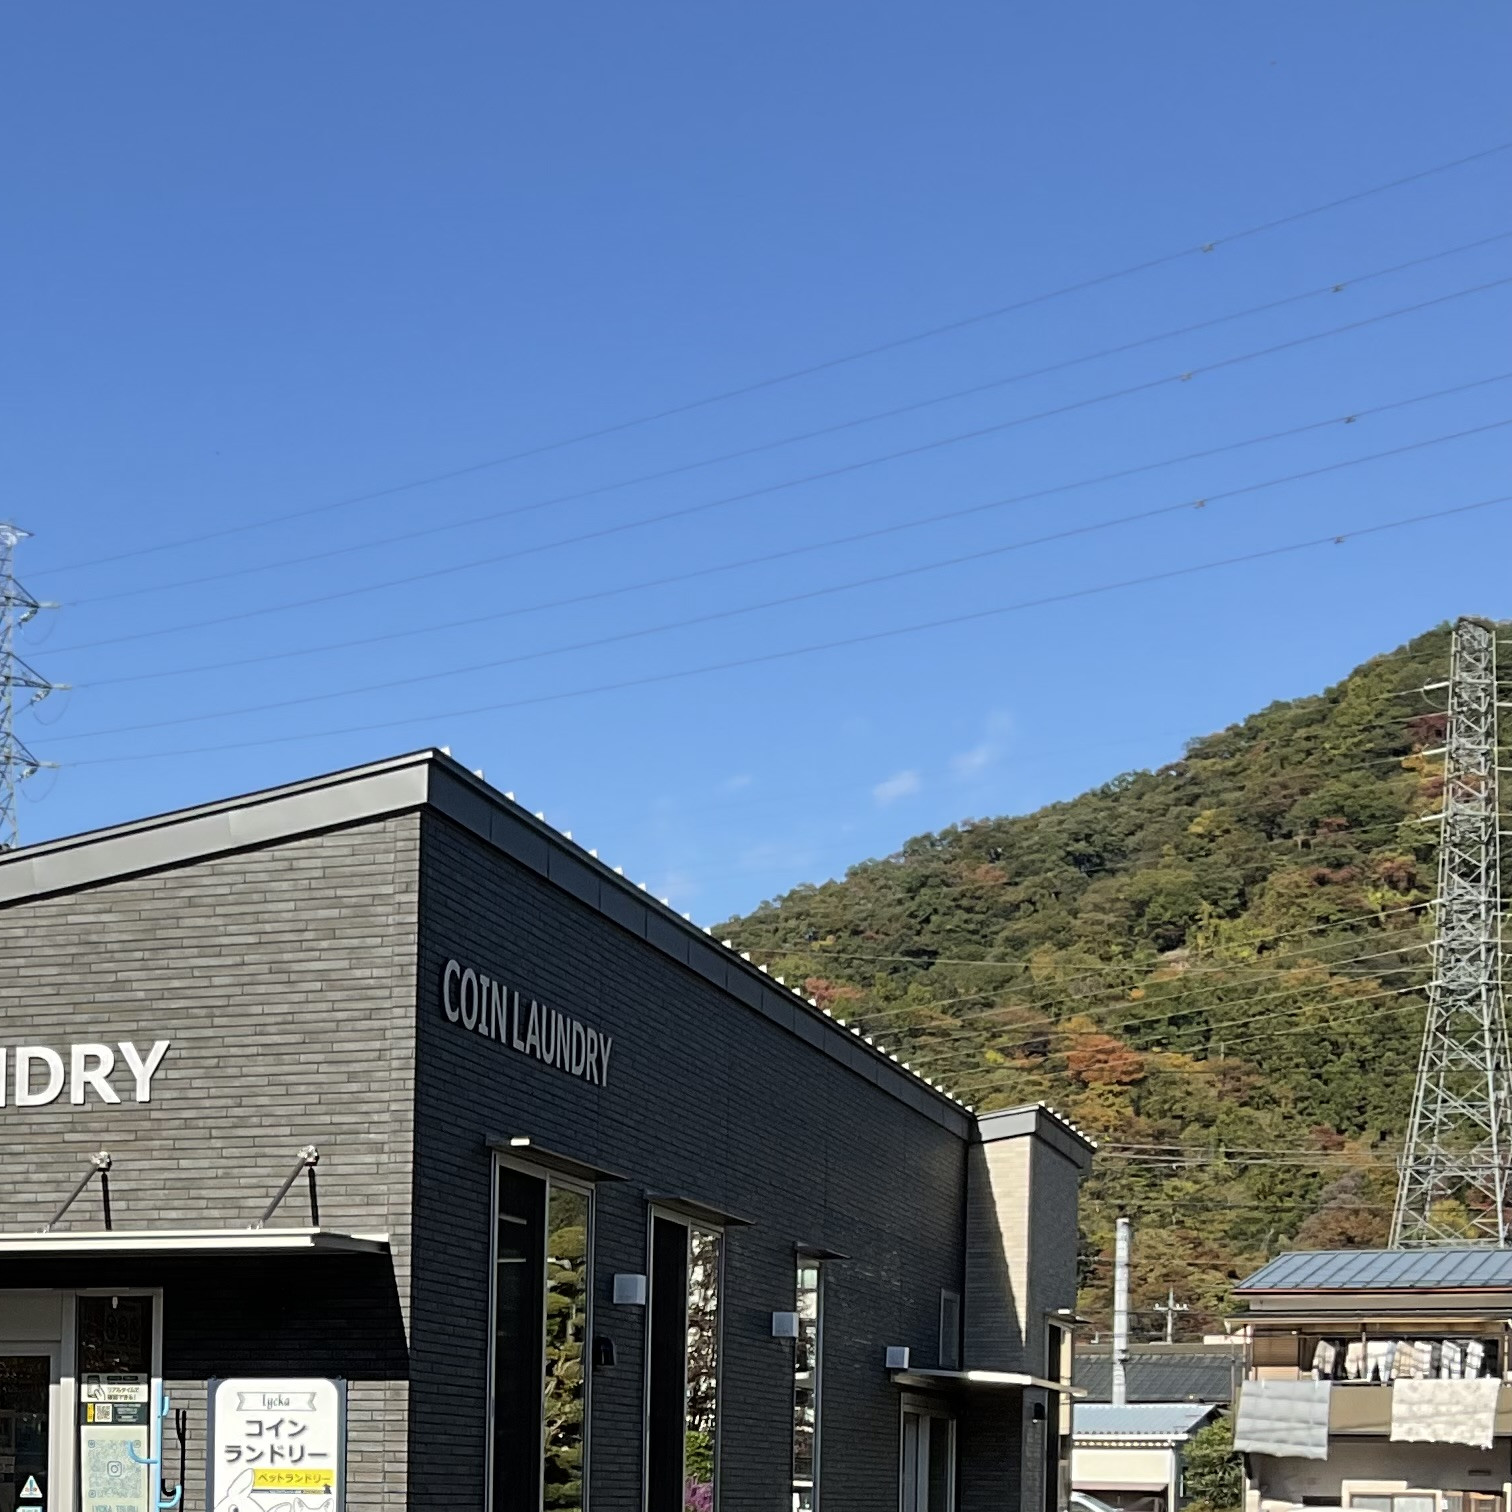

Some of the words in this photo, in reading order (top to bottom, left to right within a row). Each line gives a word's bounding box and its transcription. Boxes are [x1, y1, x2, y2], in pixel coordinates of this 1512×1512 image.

[442, 959, 507, 1044] COIN
[513, 991, 612, 1087] LAUNDRY
[245, 1418, 307, 1438] コイン
[224, 1444, 329, 1465] ランドリー
